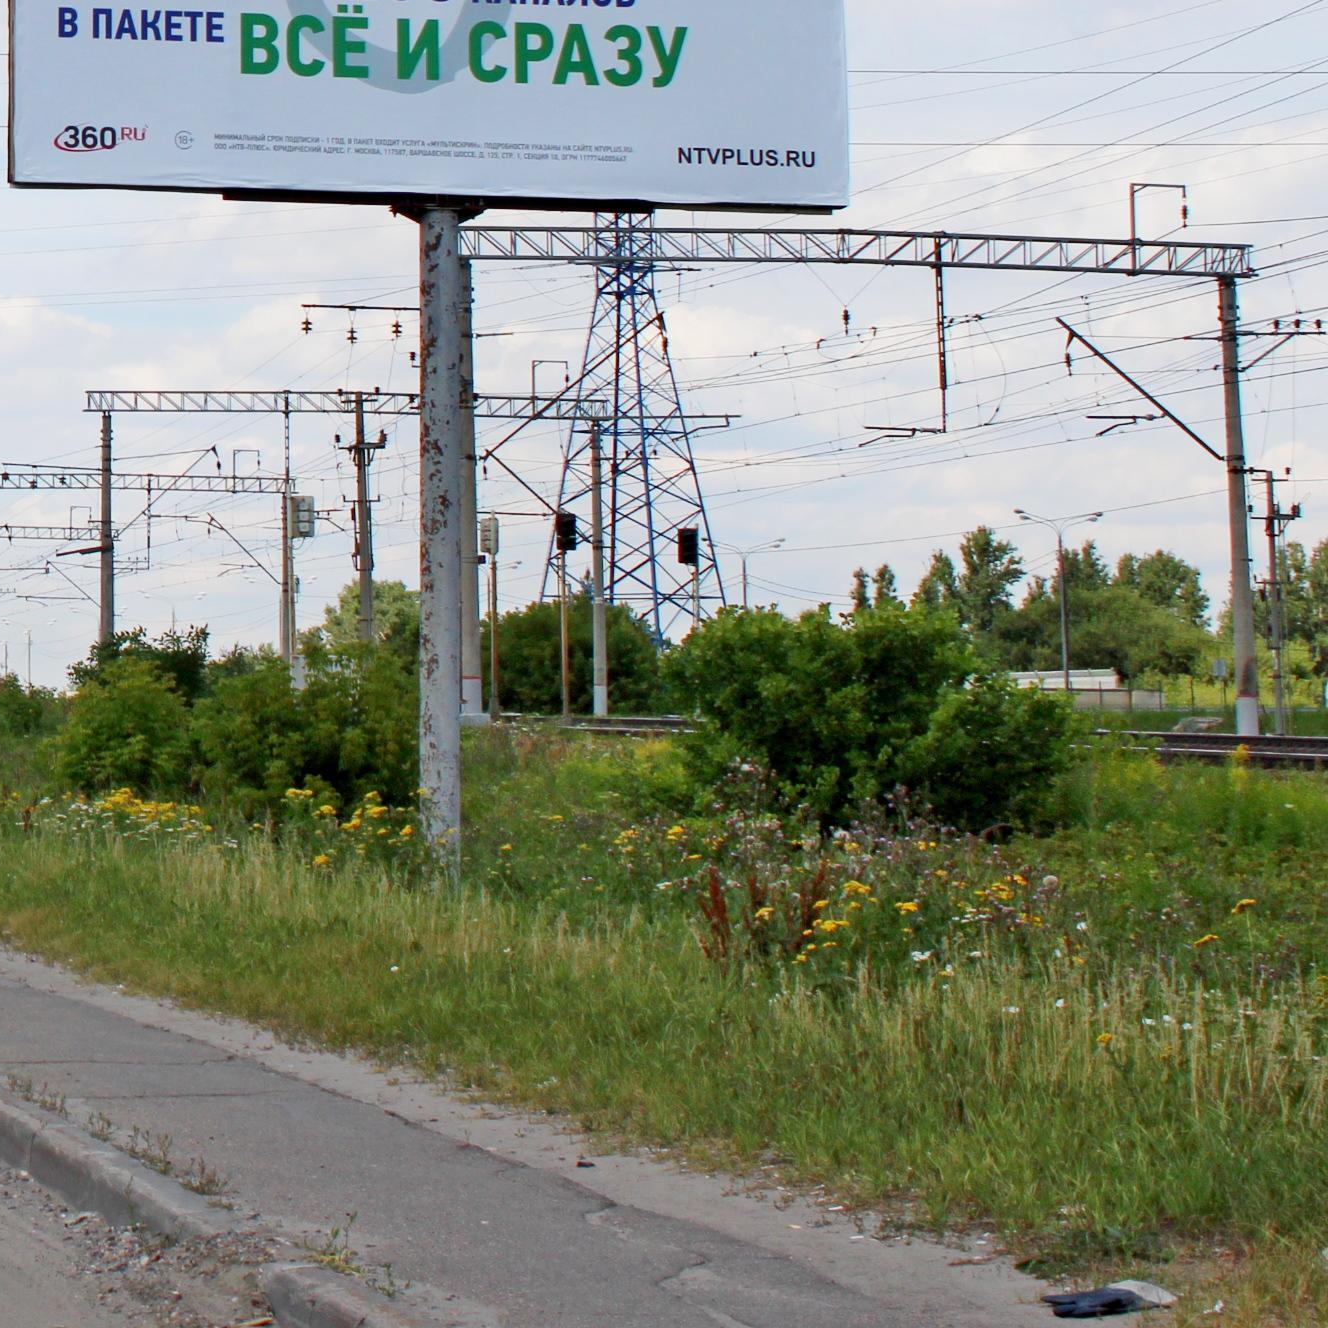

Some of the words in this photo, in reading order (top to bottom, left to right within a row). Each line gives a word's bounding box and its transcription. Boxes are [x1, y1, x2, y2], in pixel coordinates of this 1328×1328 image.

[58, 7, 78, 38] В
[92, 7, 225, 43] ПАКЕТЕ
[239, 4, 370, 80] ВСЁ
[396, 18, 440, 81] И
[467, 20, 688, 88] СРАЗУ
[177, 135, 194, 145] 18+
[677, 147, 816, 168] NTVPLUS.RU
